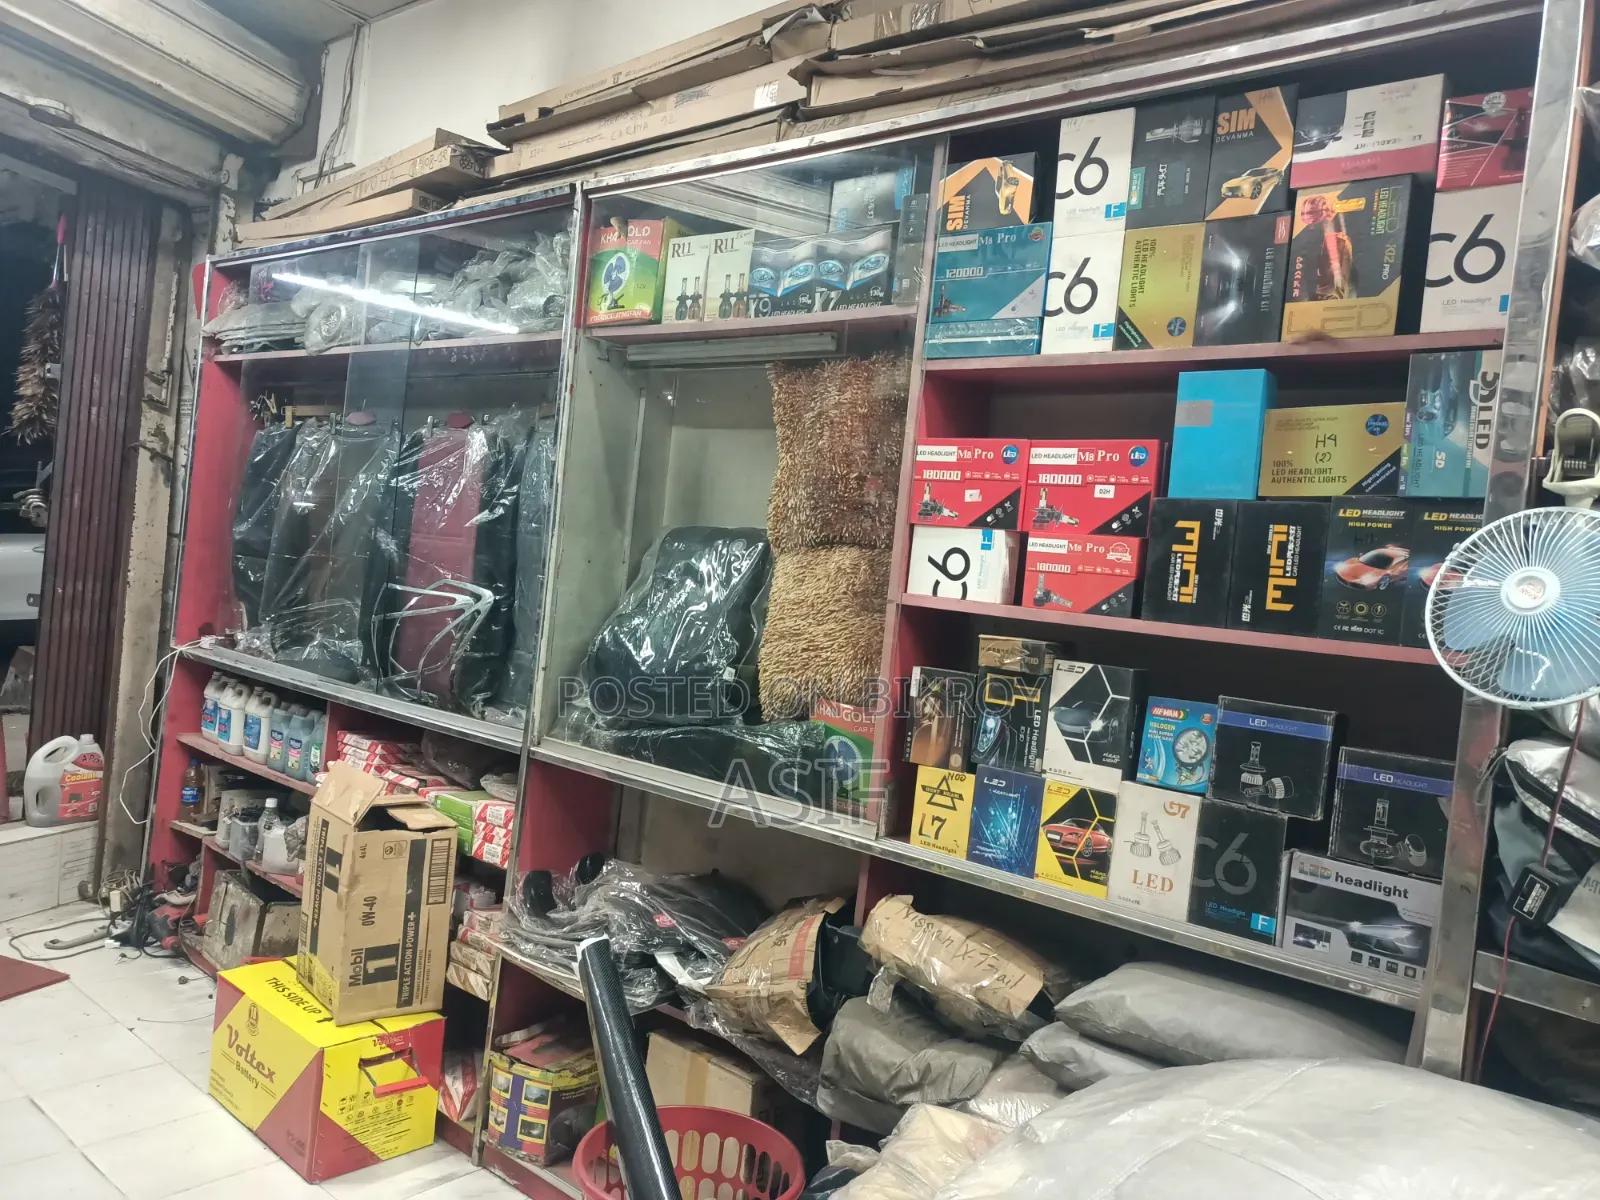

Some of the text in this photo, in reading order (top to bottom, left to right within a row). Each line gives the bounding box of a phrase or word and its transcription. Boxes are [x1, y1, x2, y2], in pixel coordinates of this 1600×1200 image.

[1216, 108, 1258, 135] SIM
[1216, 132, 1254, 143] DEVANMA
[1380, 188, 1390, 200] LED
[946, 195, 966, 231] SIM
[963, 194, 971, 230] DEVANMA
[601, 226, 650, 244] KHA OLD
[996, 232, 1017, 244] Pro
[946, 266, 984, 278] 120000
[1129, 240, 1142, 308] AUTHENTIC LIGHTS
[1138, 254, 1148, 294] HEADLIGHT
[1382, 264, 1391, 280] PRO
[1476, 406, 1492, 450] LED
[1316, 433, 1337, 448] H4
[958, 450, 972, 459] M8
[974, 448, 994, 459] Pro
[1078, 452, 1094, 461] M8
[1098, 450, 1120, 462] Pro
[1273, 460, 1294, 468] 100%
[1288, 467, 1333, 476] HEADLIGHT
[923, 470, 961, 480] 180000
[1038, 474, 1082, 485] 180000
[1271, 475, 1347, 484] AUTHENTIC LIGHTS
[1338, 508, 1406, 518] LED HEADLIGHT
[1424, 512, 1448, 520] LED
[1068, 543, 1082, 551] M8
[1086, 543, 1105, 553] Pro
[1036, 562, 1071, 573] 180000
[1249, 718, 1298, 731] LED HEADLIGHT
[1029, 710, 1042, 769] LED Headlight
[65, 771, 97, 782] Coolant
[1373, 772, 1394, 783] LED
[918, 812, 947, 840] L7
[932, 843, 957, 854] Headlight
[315, 855, 324, 887] ACTION
[1132, 869, 1174, 892] LED
[1335, 872, 1409, 899] headlight
[362, 895, 377, 927] 0W-40
[1220, 904, 1246, 917] Headlight
[349, 948, 364, 987] Mobil
[404, 949, 413, 974] ACTION
[265, 977, 322, 1014] THIS SIDE UP
[402, 976, 411, 1000] TRIPLE
[227, 1023, 276, 1084] Voltex
[236, 1060, 260, 1089] Battery
